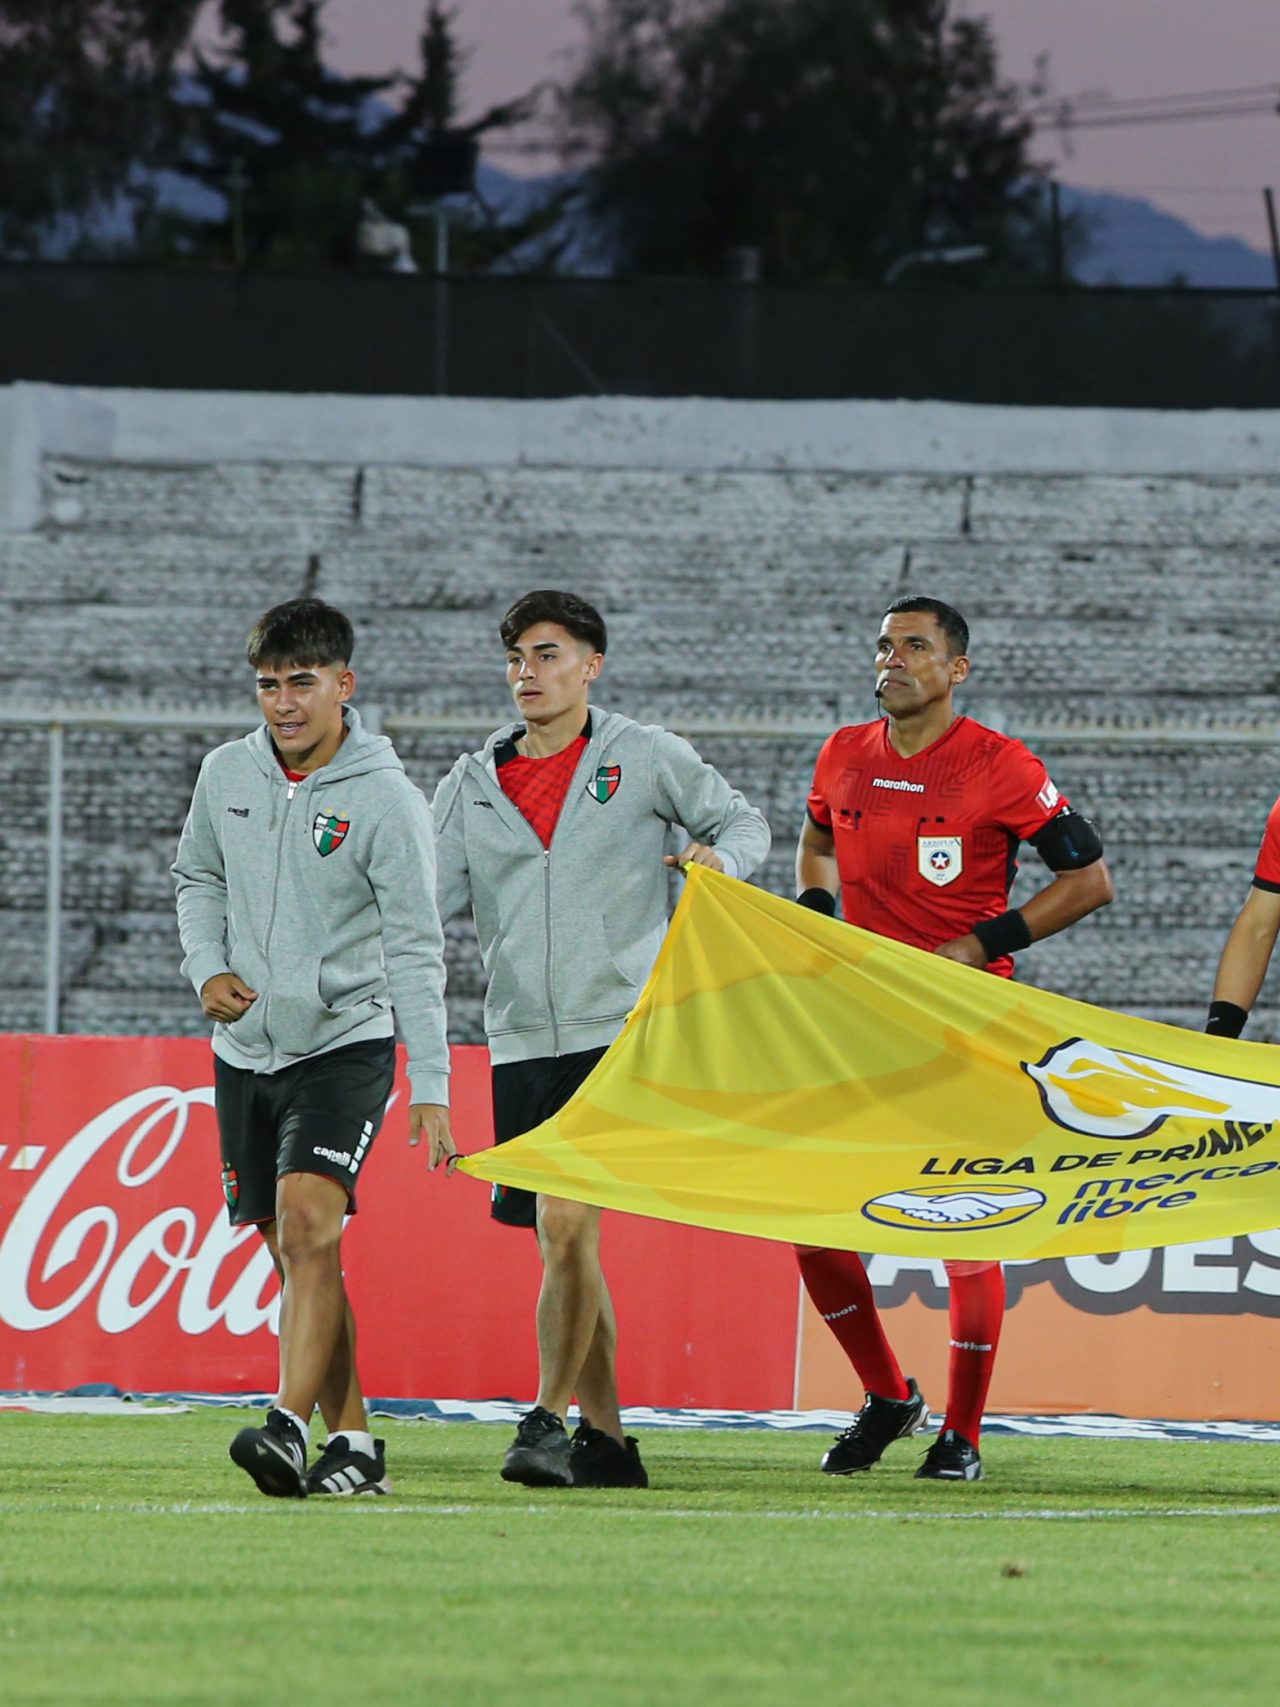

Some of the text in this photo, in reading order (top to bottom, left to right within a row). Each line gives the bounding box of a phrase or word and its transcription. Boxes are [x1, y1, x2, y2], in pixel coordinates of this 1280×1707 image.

[872, 778, 925, 793] marathon
[920, 1157, 1036, 1176] LIGA
[1050, 1150, 1118, 1173] DE
[1056, 1190, 1198, 1226] libre
